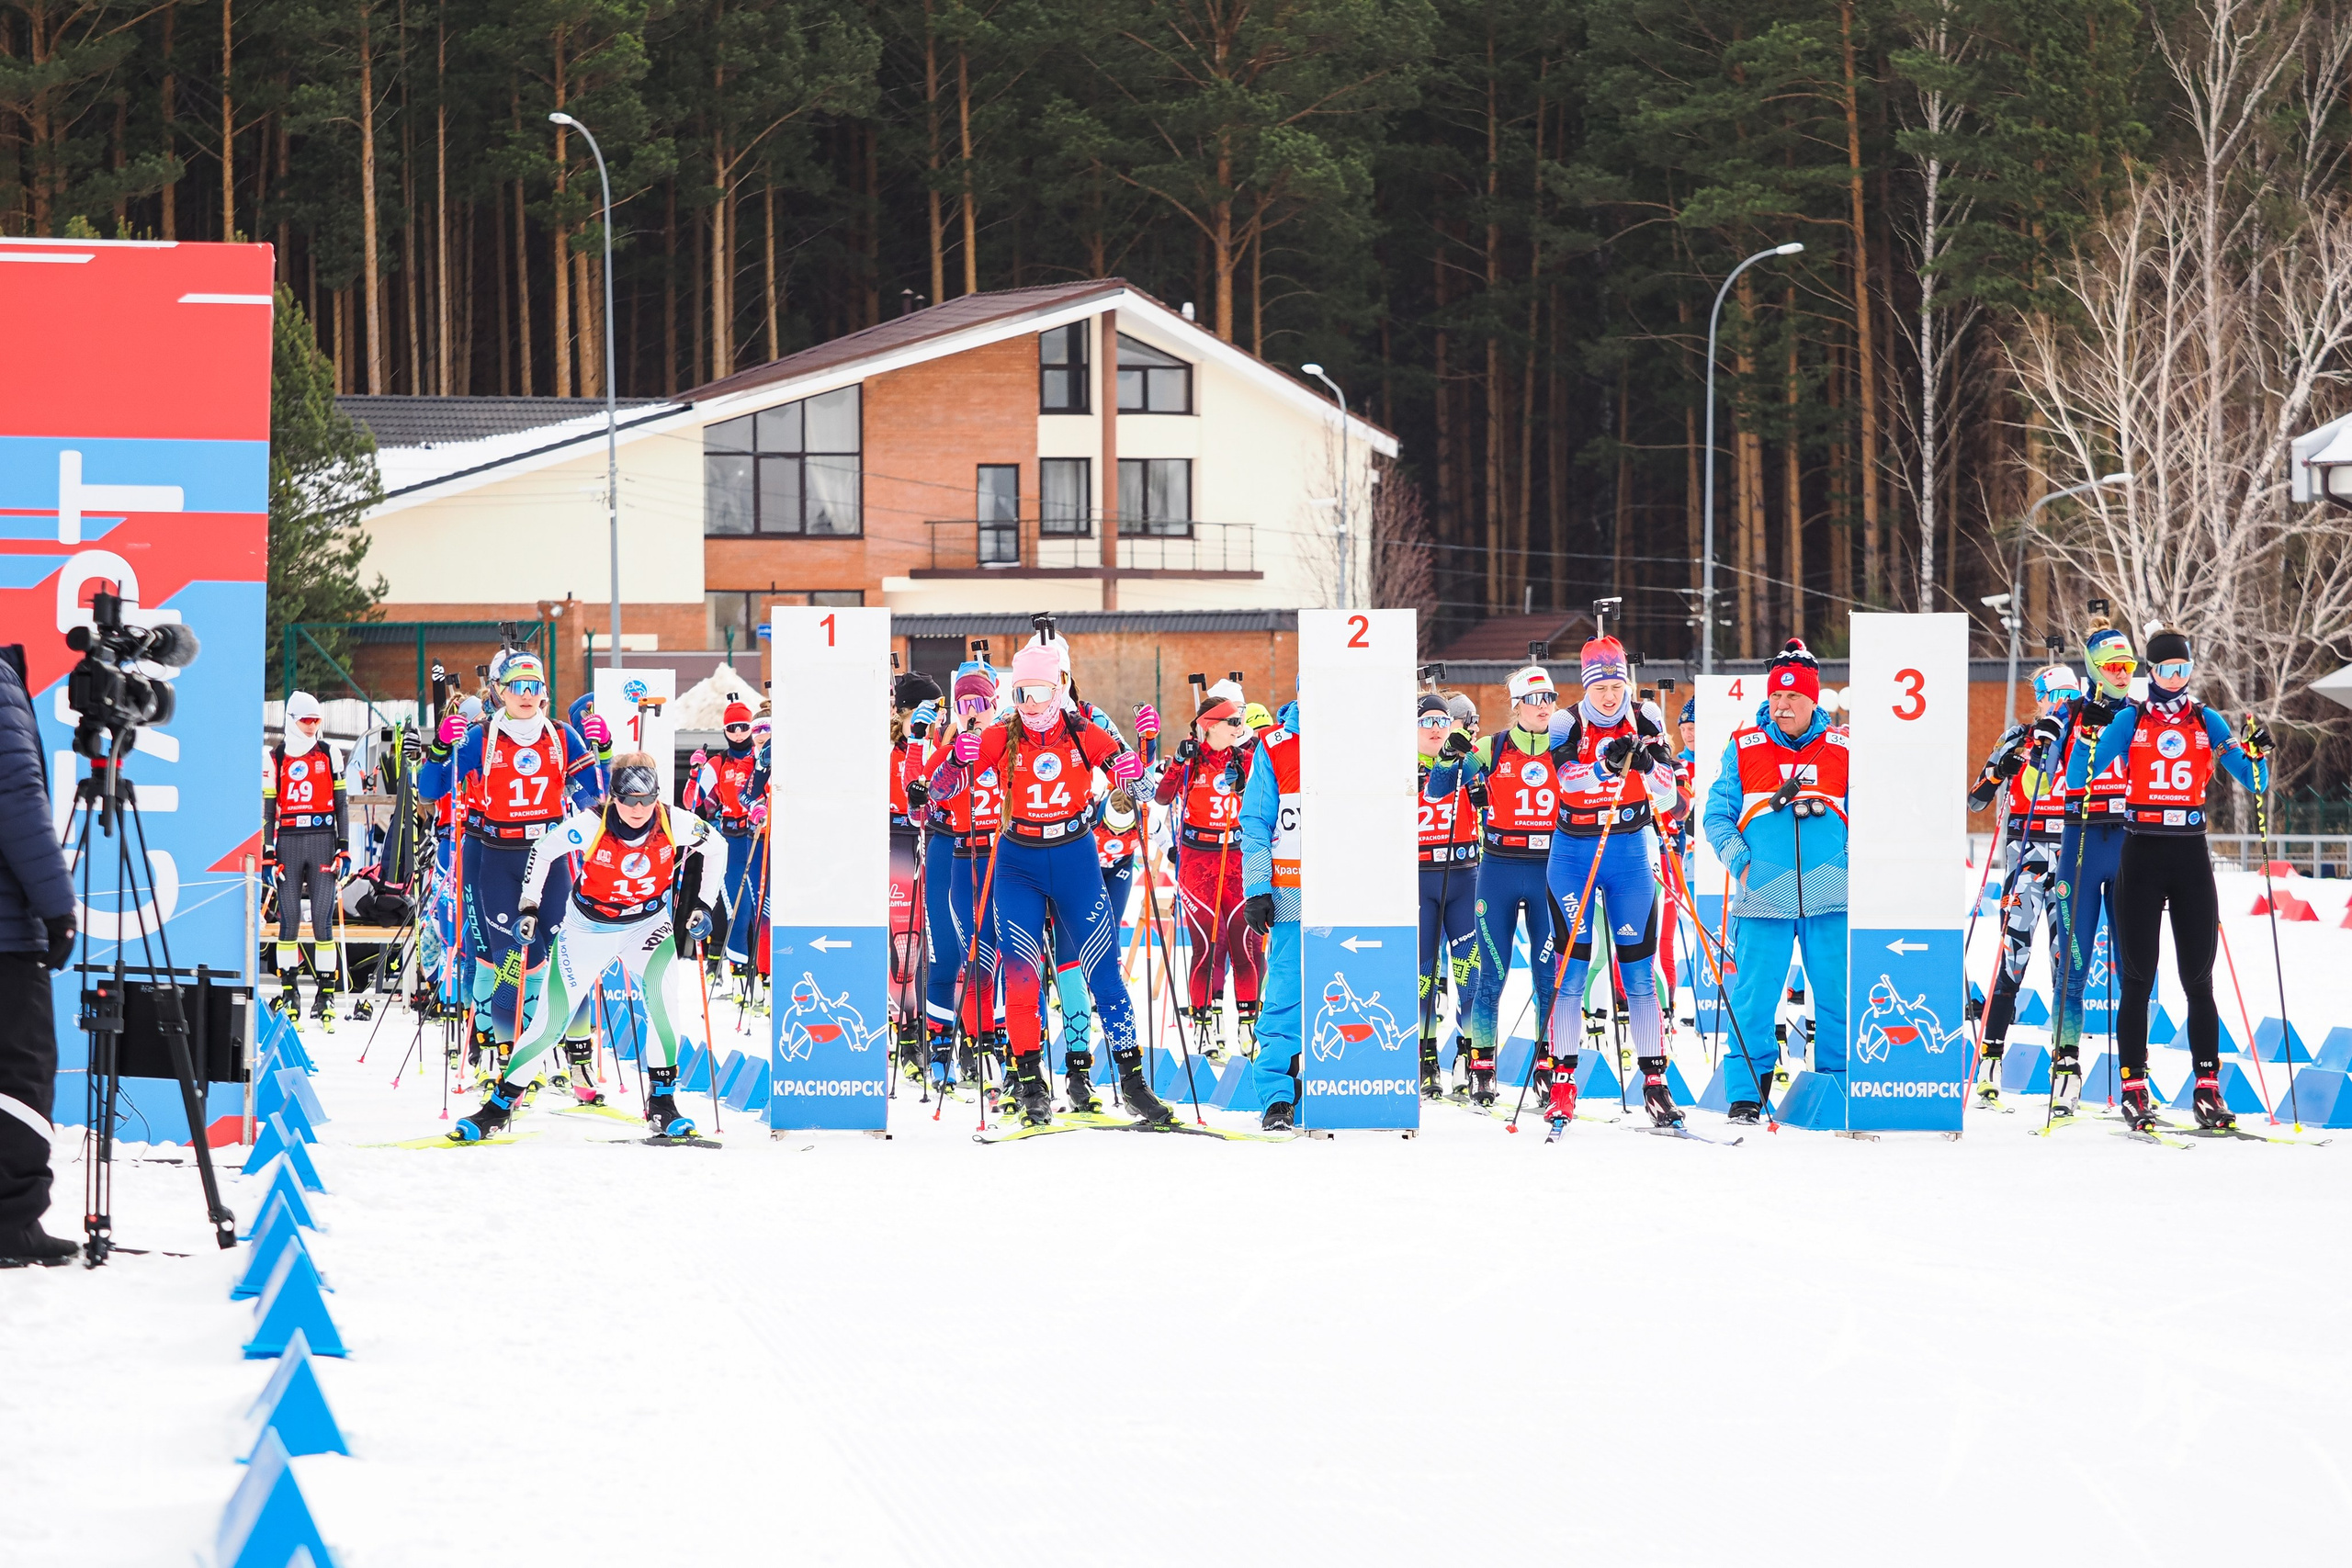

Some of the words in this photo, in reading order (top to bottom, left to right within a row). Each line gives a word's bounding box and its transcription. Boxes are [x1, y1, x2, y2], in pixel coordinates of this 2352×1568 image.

[819, 614, 835, 647] 1
[1347, 615, 1370, 649] 2
[1728, 678, 1744, 701] 4
[1892, 668, 1927, 721] 3
[626, 715, 639, 742] 1
[1273, 731, 1283, 741] 8
[1744, 734, 1760, 745] 35
[2148, 759, 2193, 791] 16
[286, 780, 313, 803] 49
[508, 776, 549, 807] 17
[1026, 781, 1072, 809] 14
[1514, 788, 1555, 817] 19
[2148, 794, 2190, 802] КРАСНОЯРСК
[509, 809, 548, 818] КРАСНОЯРСК
[1027, 809, 1069, 818] КРАСНОЯРСК
[1209, 795, 1238, 819] 39
[1418, 803, 1453, 832] 23
[610, 876, 657, 897] 13
[560, 944, 577, 987] ЮГОРИЯ
[773, 1079, 885, 1097] КРАСНОЯРСК
[1306, 1078, 1417, 1096] КРАСНОЯРСК
[1850, 1082, 1961, 1098] КРАСНОЯРСК
